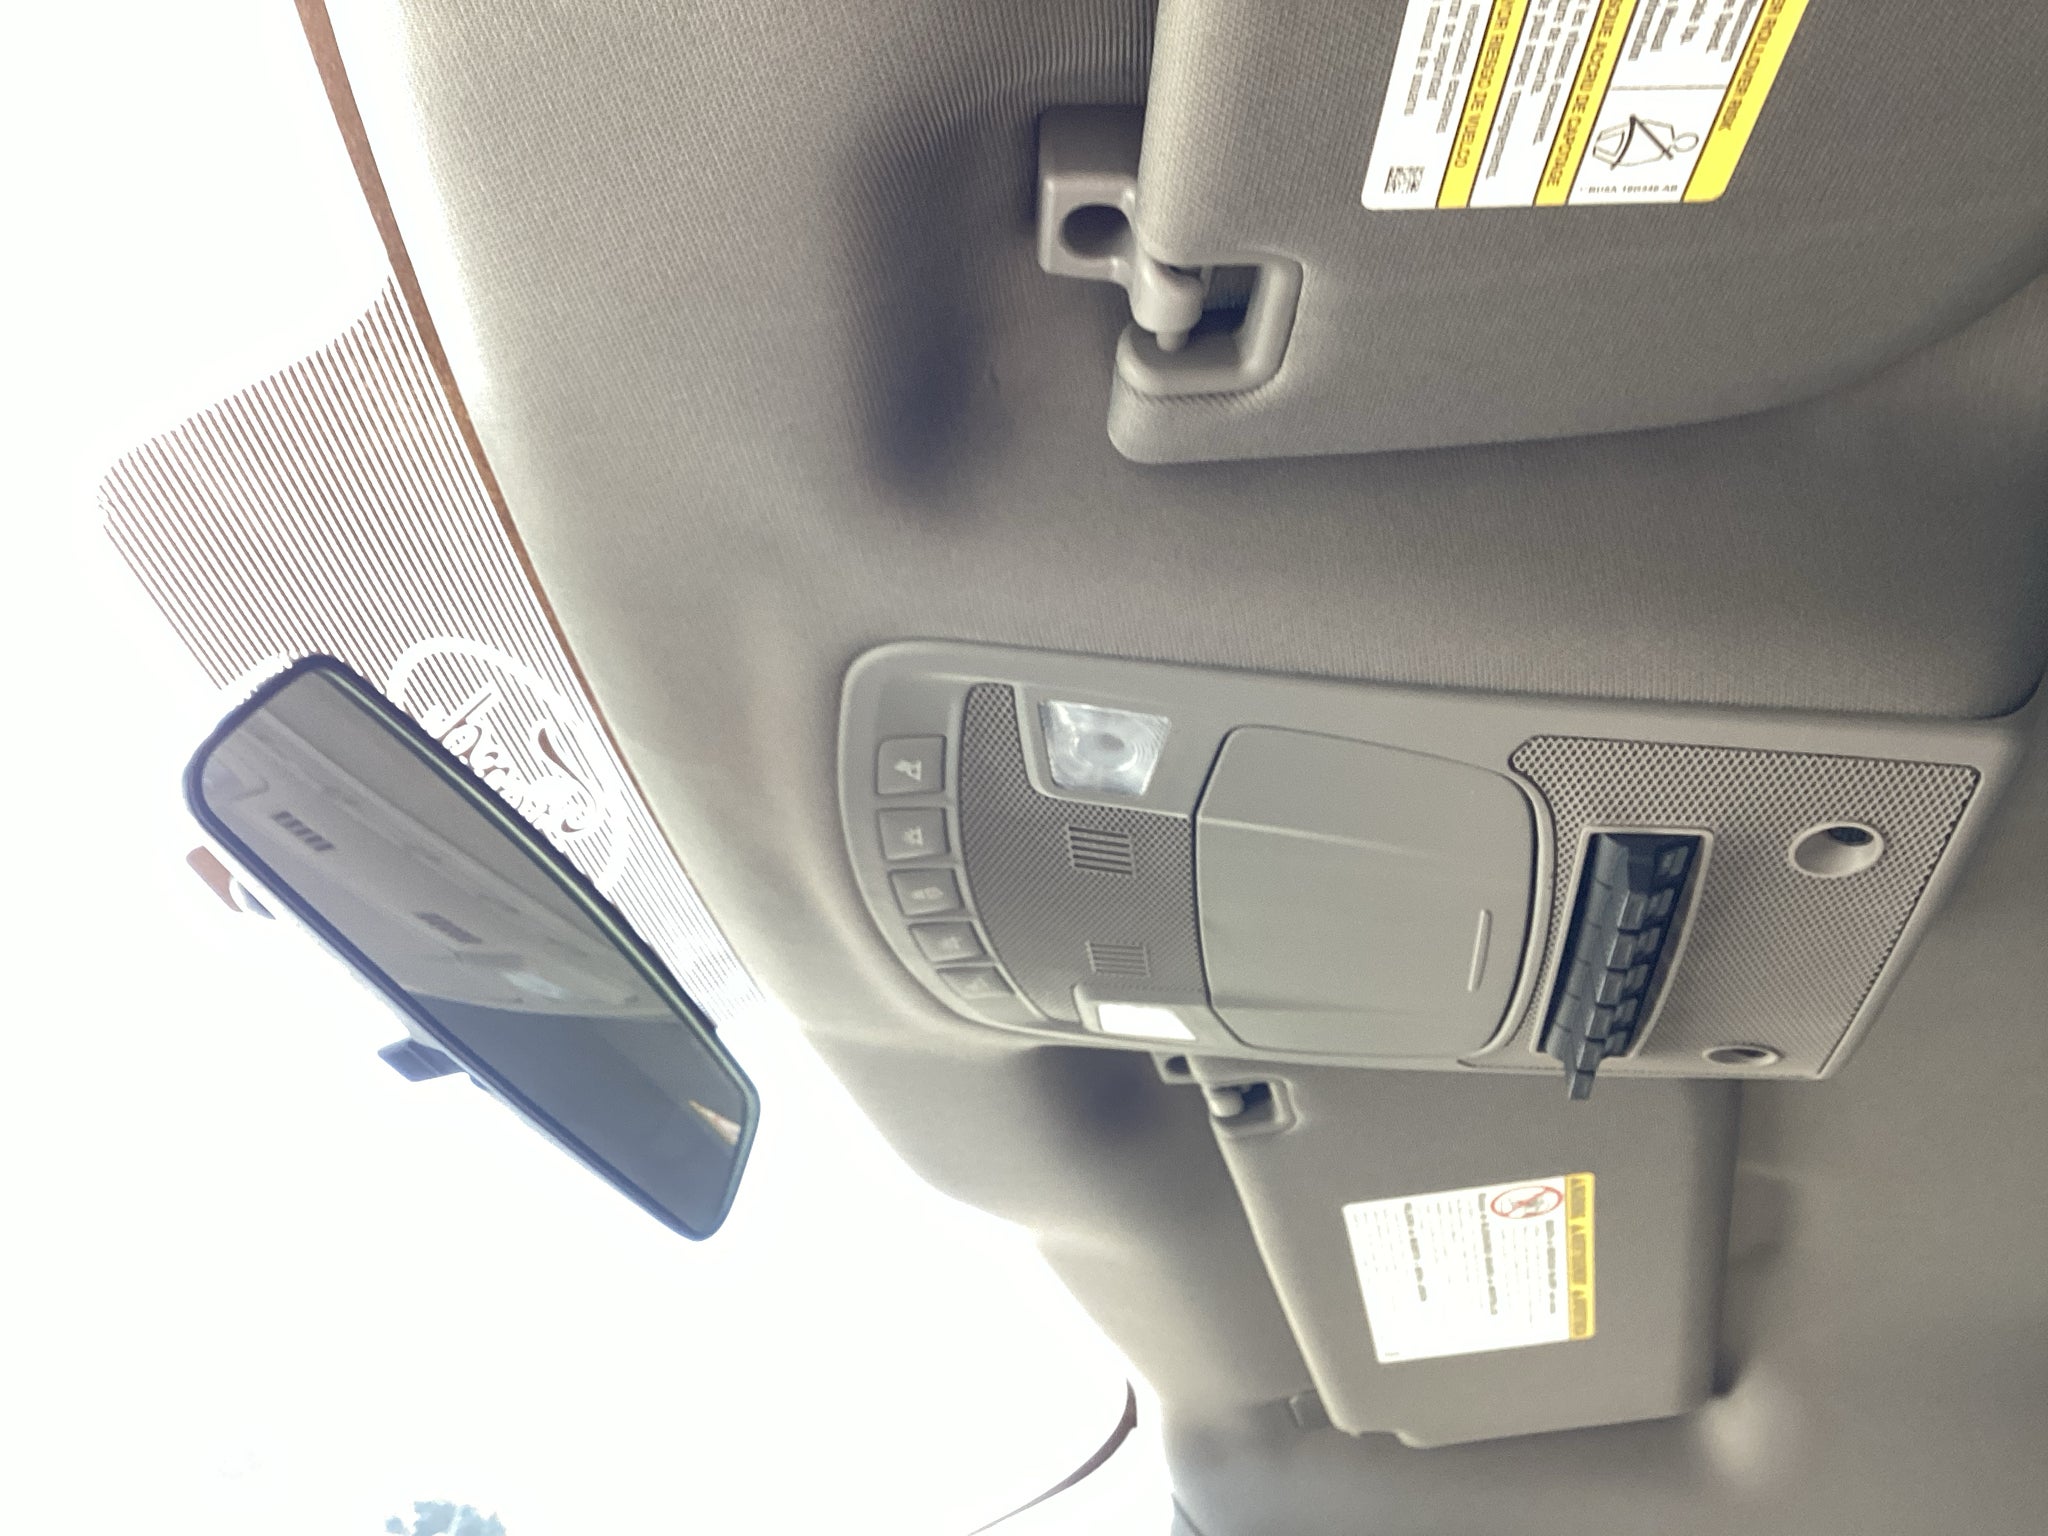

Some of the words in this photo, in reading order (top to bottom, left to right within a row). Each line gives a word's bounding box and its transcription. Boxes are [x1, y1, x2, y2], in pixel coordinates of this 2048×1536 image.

[1478, 34, 1505, 89] RIESGO
[1580, 41, 1607, 91] ACCRU
[1733, 17, 1777, 97] ROLLOVER
[1470, 92, 1488, 111] DE
[1571, 94, 1589, 114] DE
[1718, 99, 1743, 131] RISK
[1454, 114, 1482, 168] VUELCO
[1546, 116, 1582, 187] CAPOTAGE
